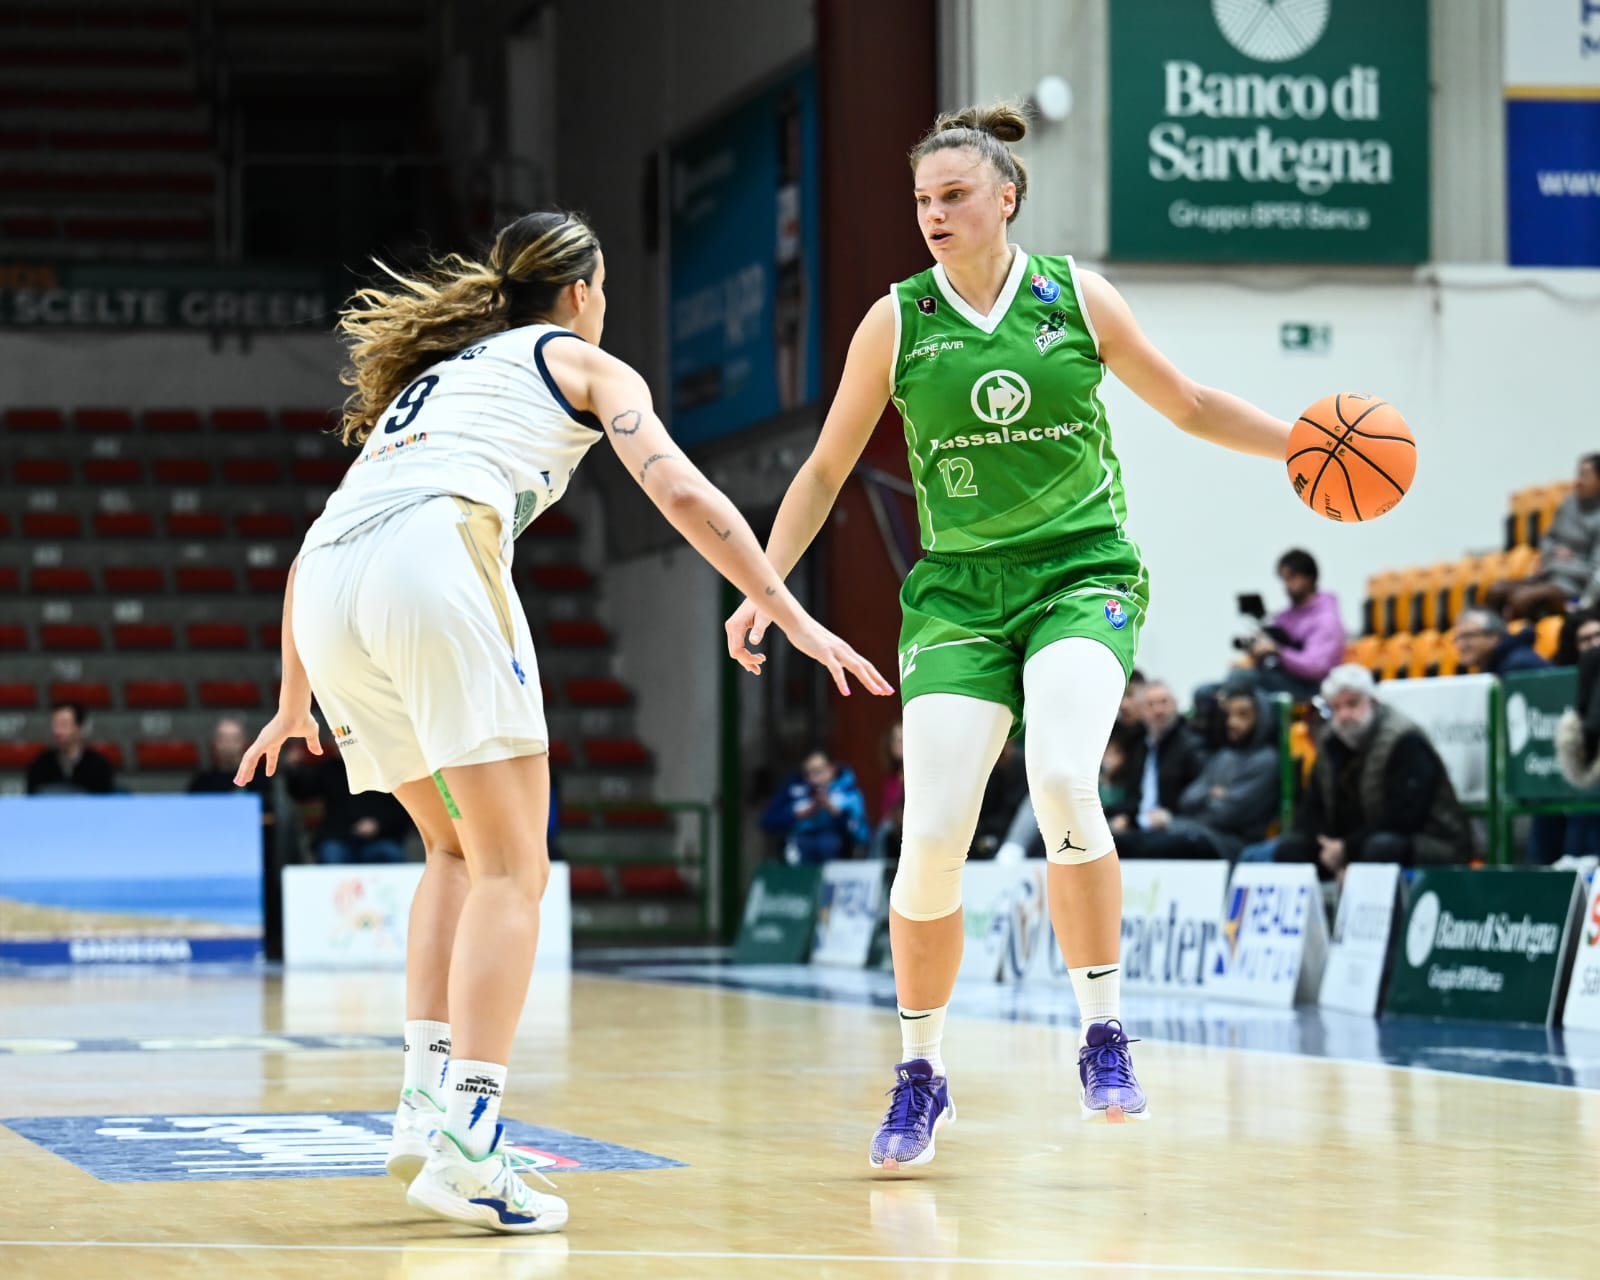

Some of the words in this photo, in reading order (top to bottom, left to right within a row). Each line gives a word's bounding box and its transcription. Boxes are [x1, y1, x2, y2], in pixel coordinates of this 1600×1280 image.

[1164, 60, 1327, 120] Banco
[1332, 65, 1380, 121] di
[1148, 124, 1392, 195] Sardegna
[1168, 199, 1249, 233] Gruppo
[1304, 202, 1370, 230] Banca
[14, 288, 166, 324] SCELTE
[180, 288, 326, 325] GREEN
[940, 340, 964, 350] AVIR
[384, 375, 440, 434] 9
[937, 457, 978, 498] 12
[1436, 910, 1477, 949] Banco
[1476, 911, 1496, 951] di
[1491, 911, 1558, 961] Sardegna
